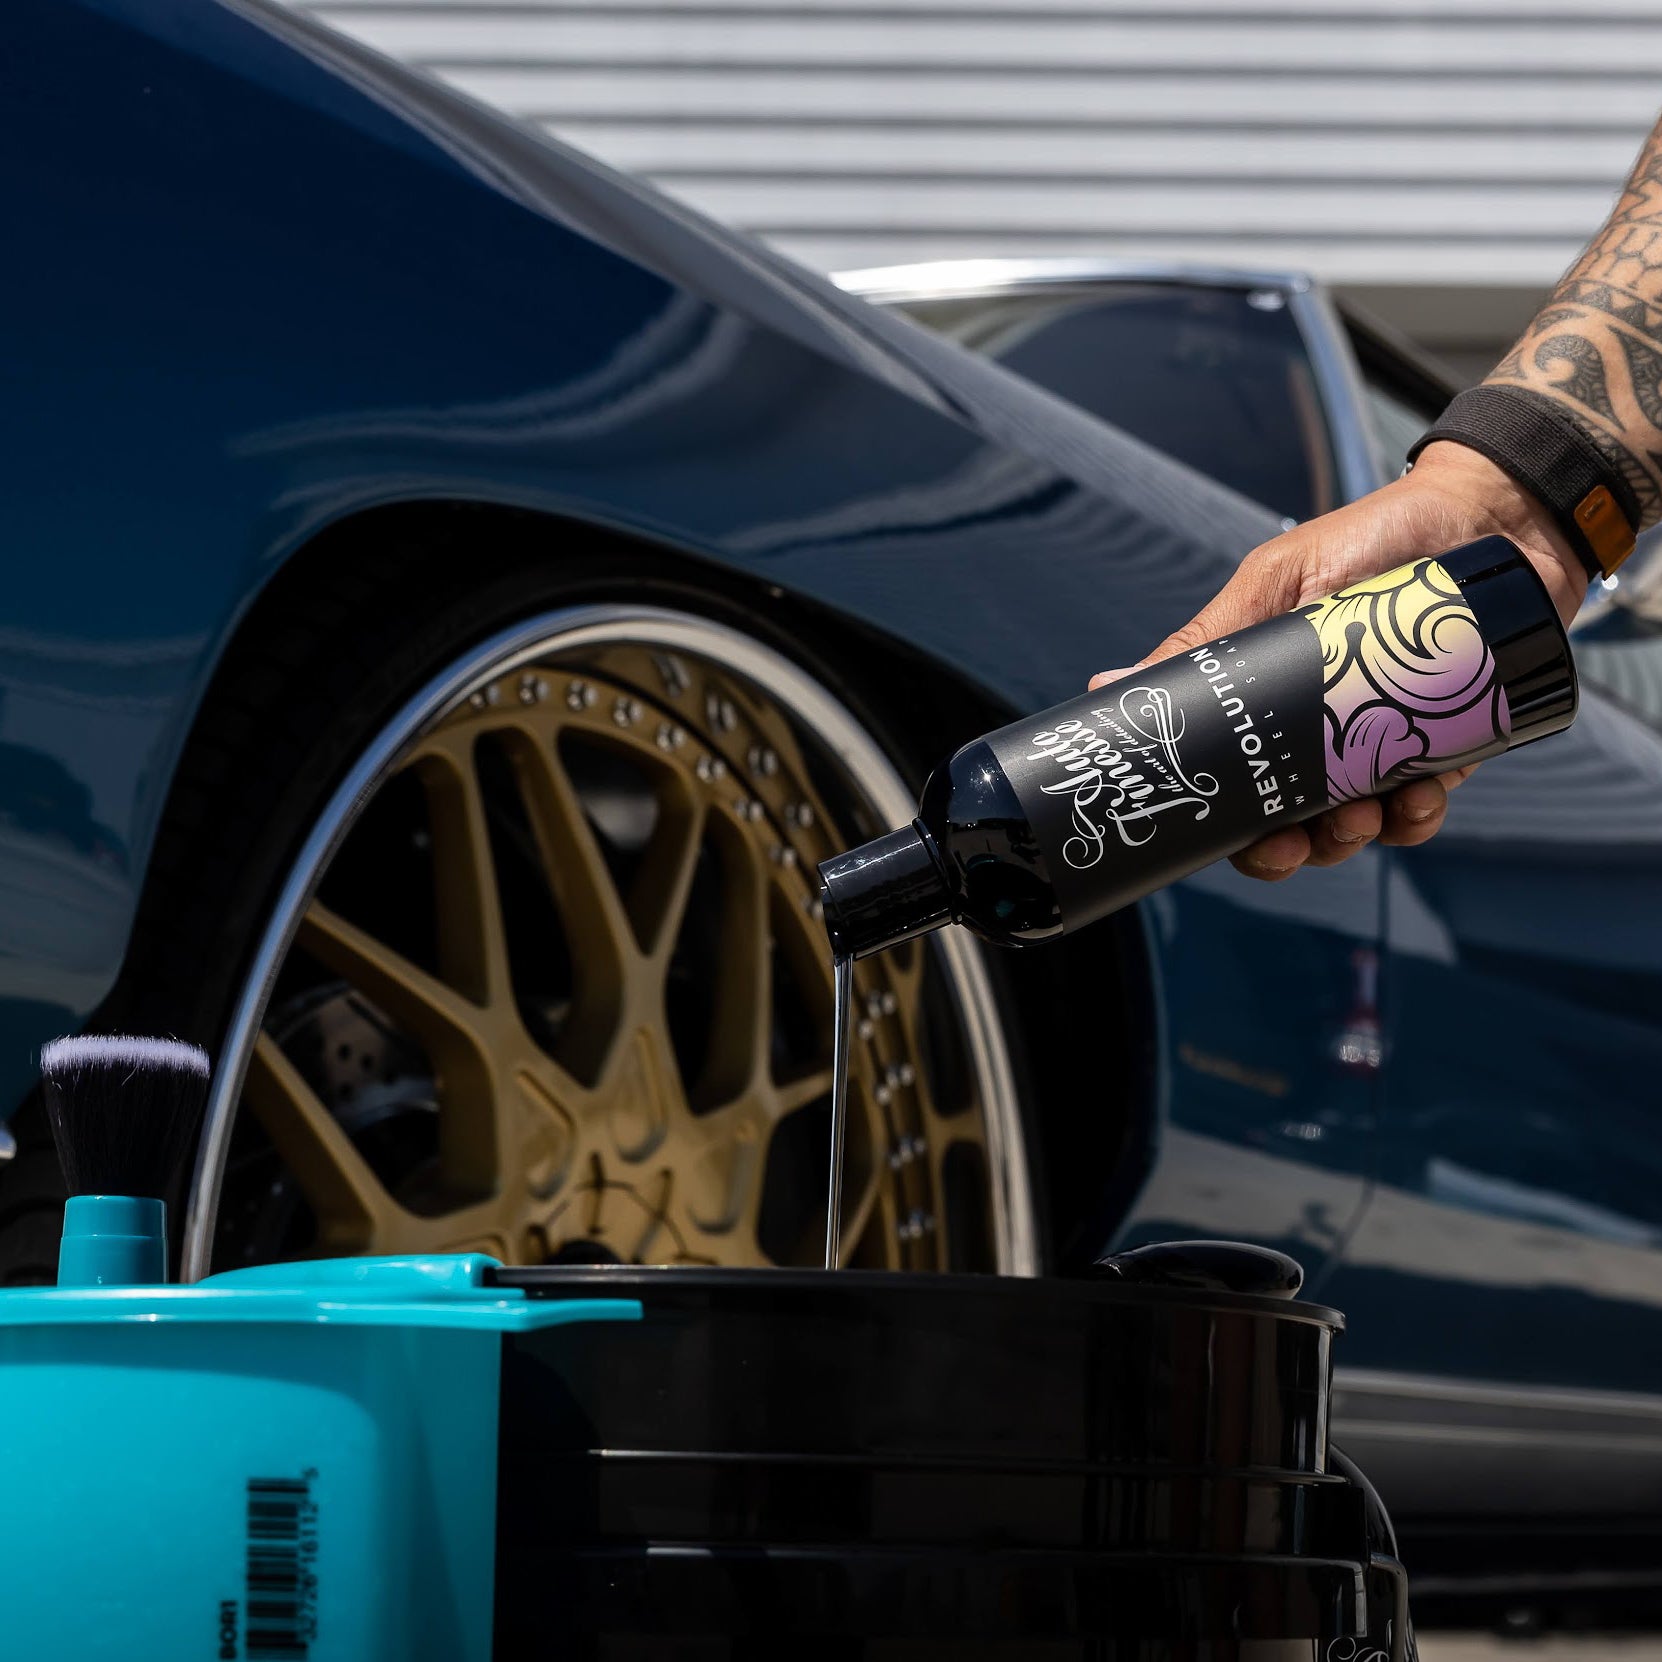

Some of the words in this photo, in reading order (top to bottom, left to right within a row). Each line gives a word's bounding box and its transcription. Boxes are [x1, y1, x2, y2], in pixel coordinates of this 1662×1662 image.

[1090, 707, 1139, 746] detailing
[1121, 743, 1158, 757] of
[1189, 648, 1285, 816] REVOLUTION
[1263, 711, 1306, 806] WHEEL
[1055, 720, 1210, 847] Finesse
[1143, 758, 1167, 774] art
[1158, 775, 1184, 793] the
[1026, 732, 1125, 869] Auto
